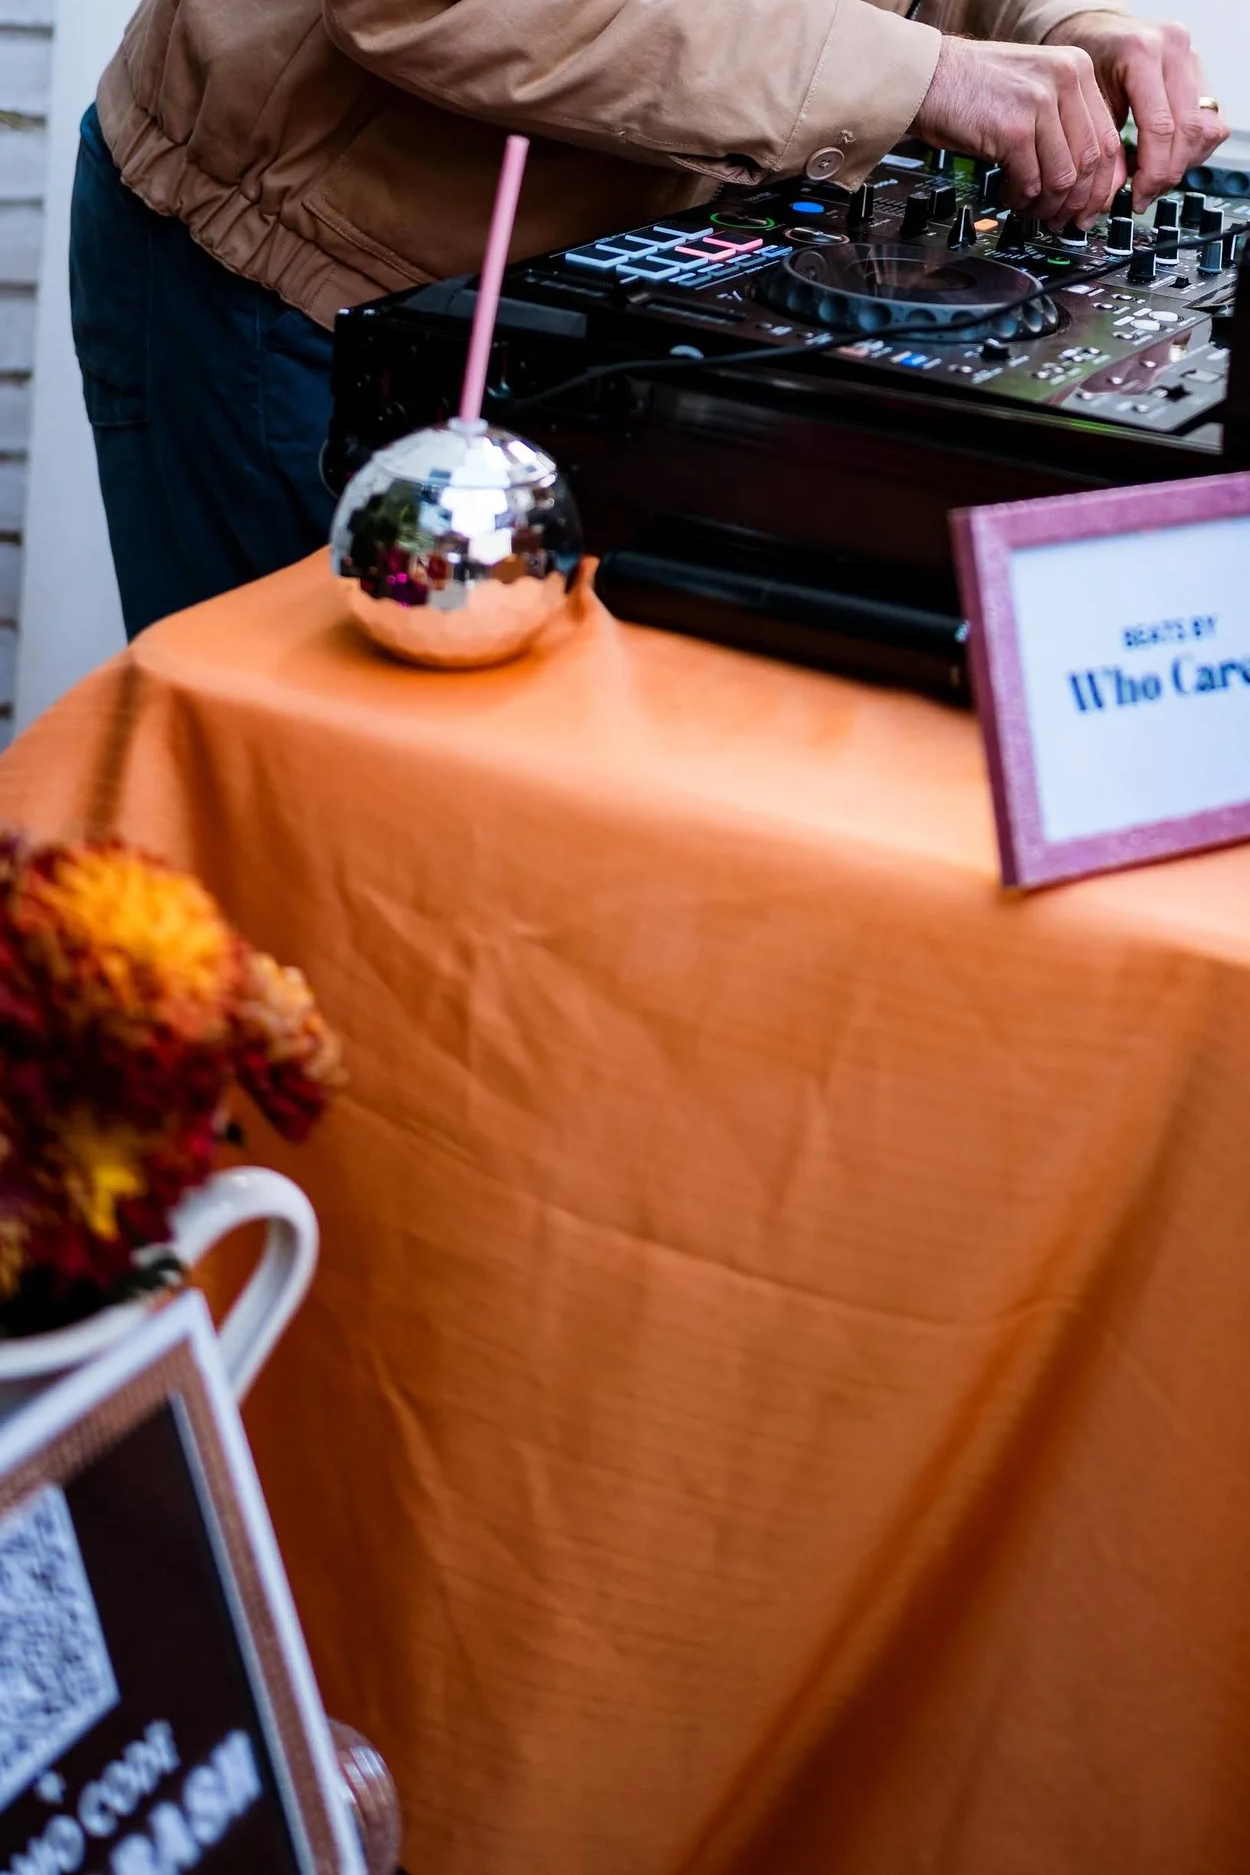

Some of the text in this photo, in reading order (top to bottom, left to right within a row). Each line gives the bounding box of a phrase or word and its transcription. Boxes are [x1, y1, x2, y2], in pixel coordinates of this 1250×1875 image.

[1122, 612, 1217, 648] BEATS BY
[1067, 665, 1162, 712] Who
